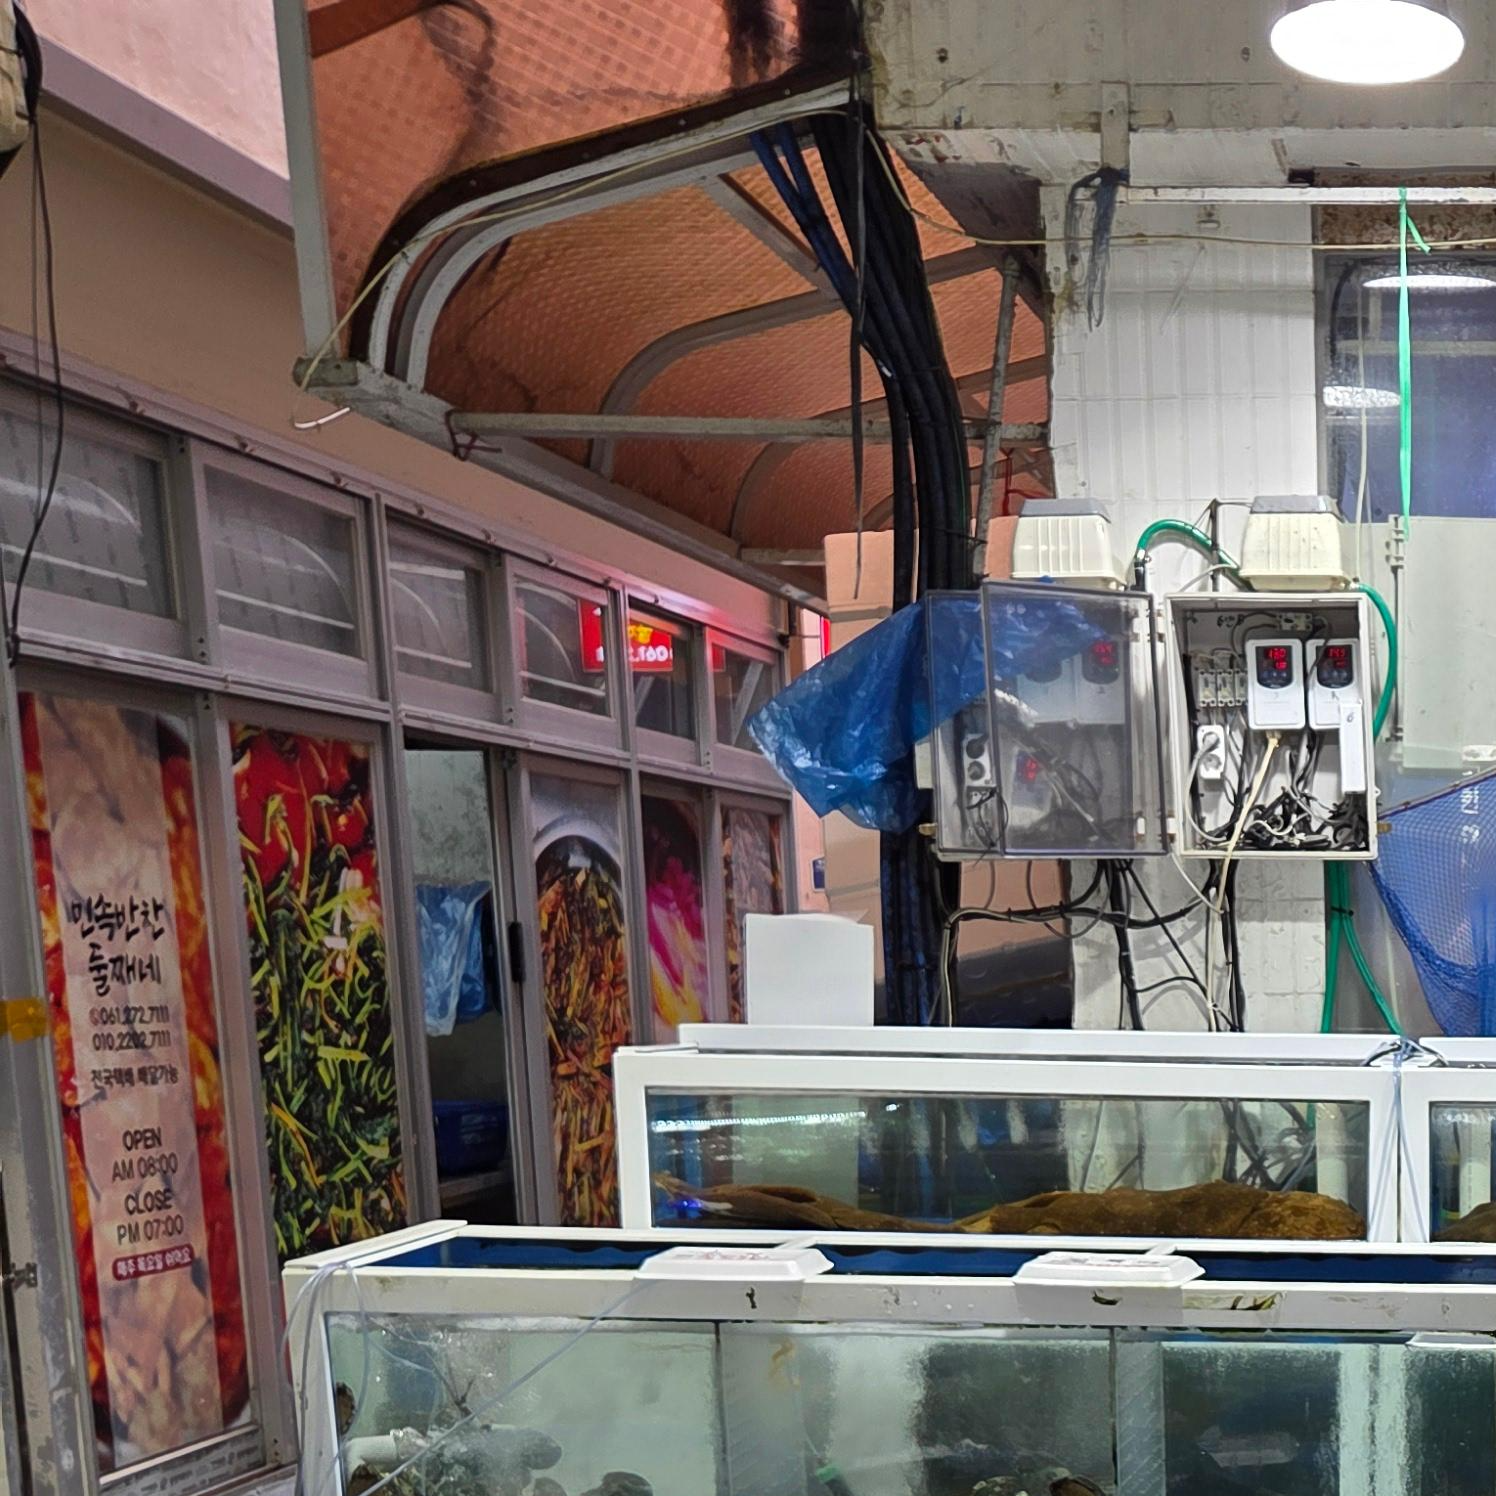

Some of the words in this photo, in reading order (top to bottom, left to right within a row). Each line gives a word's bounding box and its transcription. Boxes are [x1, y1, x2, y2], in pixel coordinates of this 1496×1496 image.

[71, 893, 165, 941] 민속반찬
[88, 942, 161, 996] 둘째네
[122, 1127, 163, 1151] OPEN
[112, 1158, 135, 1183] AM
[137, 1152, 179, 1179] 08:00
[124, 1188, 174, 1216] CLOSE
[117, 1221, 141, 1246] PM
[143, 1214, 184, 1241] 07:00
